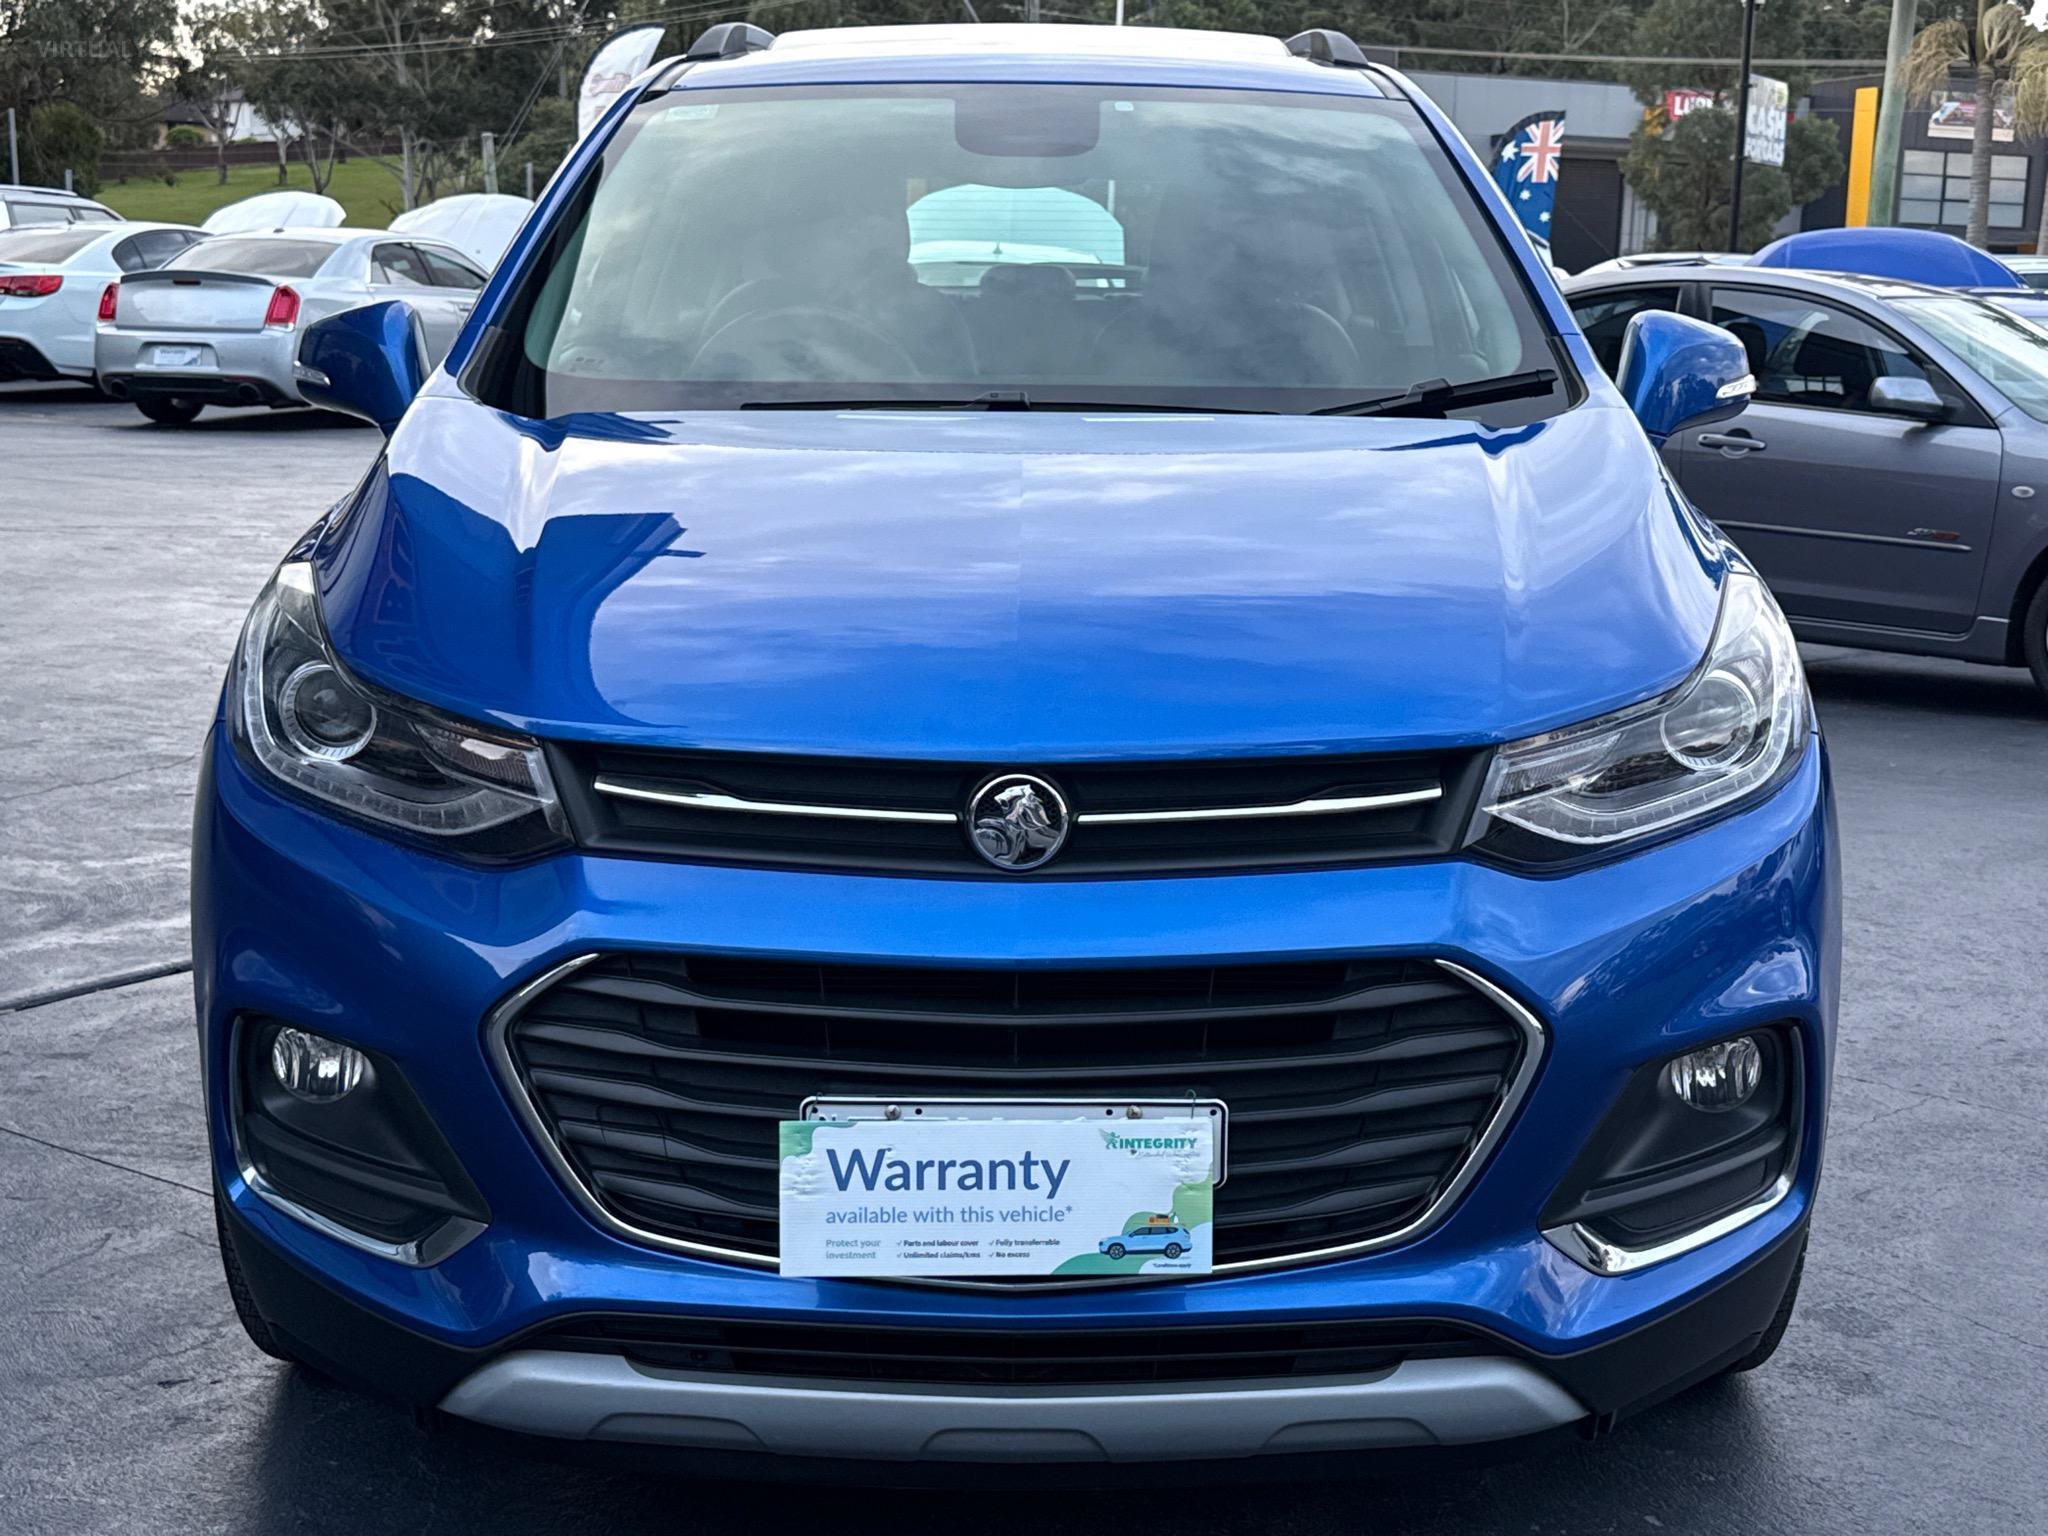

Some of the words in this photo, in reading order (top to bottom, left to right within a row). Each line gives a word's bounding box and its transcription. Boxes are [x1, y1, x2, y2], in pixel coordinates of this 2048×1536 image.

[1747, 104, 1787, 139] CASH
[1119, 1137, 1198, 1149] INTEGRITY
[826, 1148, 1071, 1199] Warranty
[826, 1206, 908, 1224] available
[913, 1206, 954, 1223] with
[960, 1206, 994, 1223] this
[825, 1239, 859, 1247] Protect
[860, 1240, 881, 1248] your
[903, 1239, 921, 1247] Parts
[922, 1239, 936, 1247] and
[825, 1251, 876, 1259] investment
